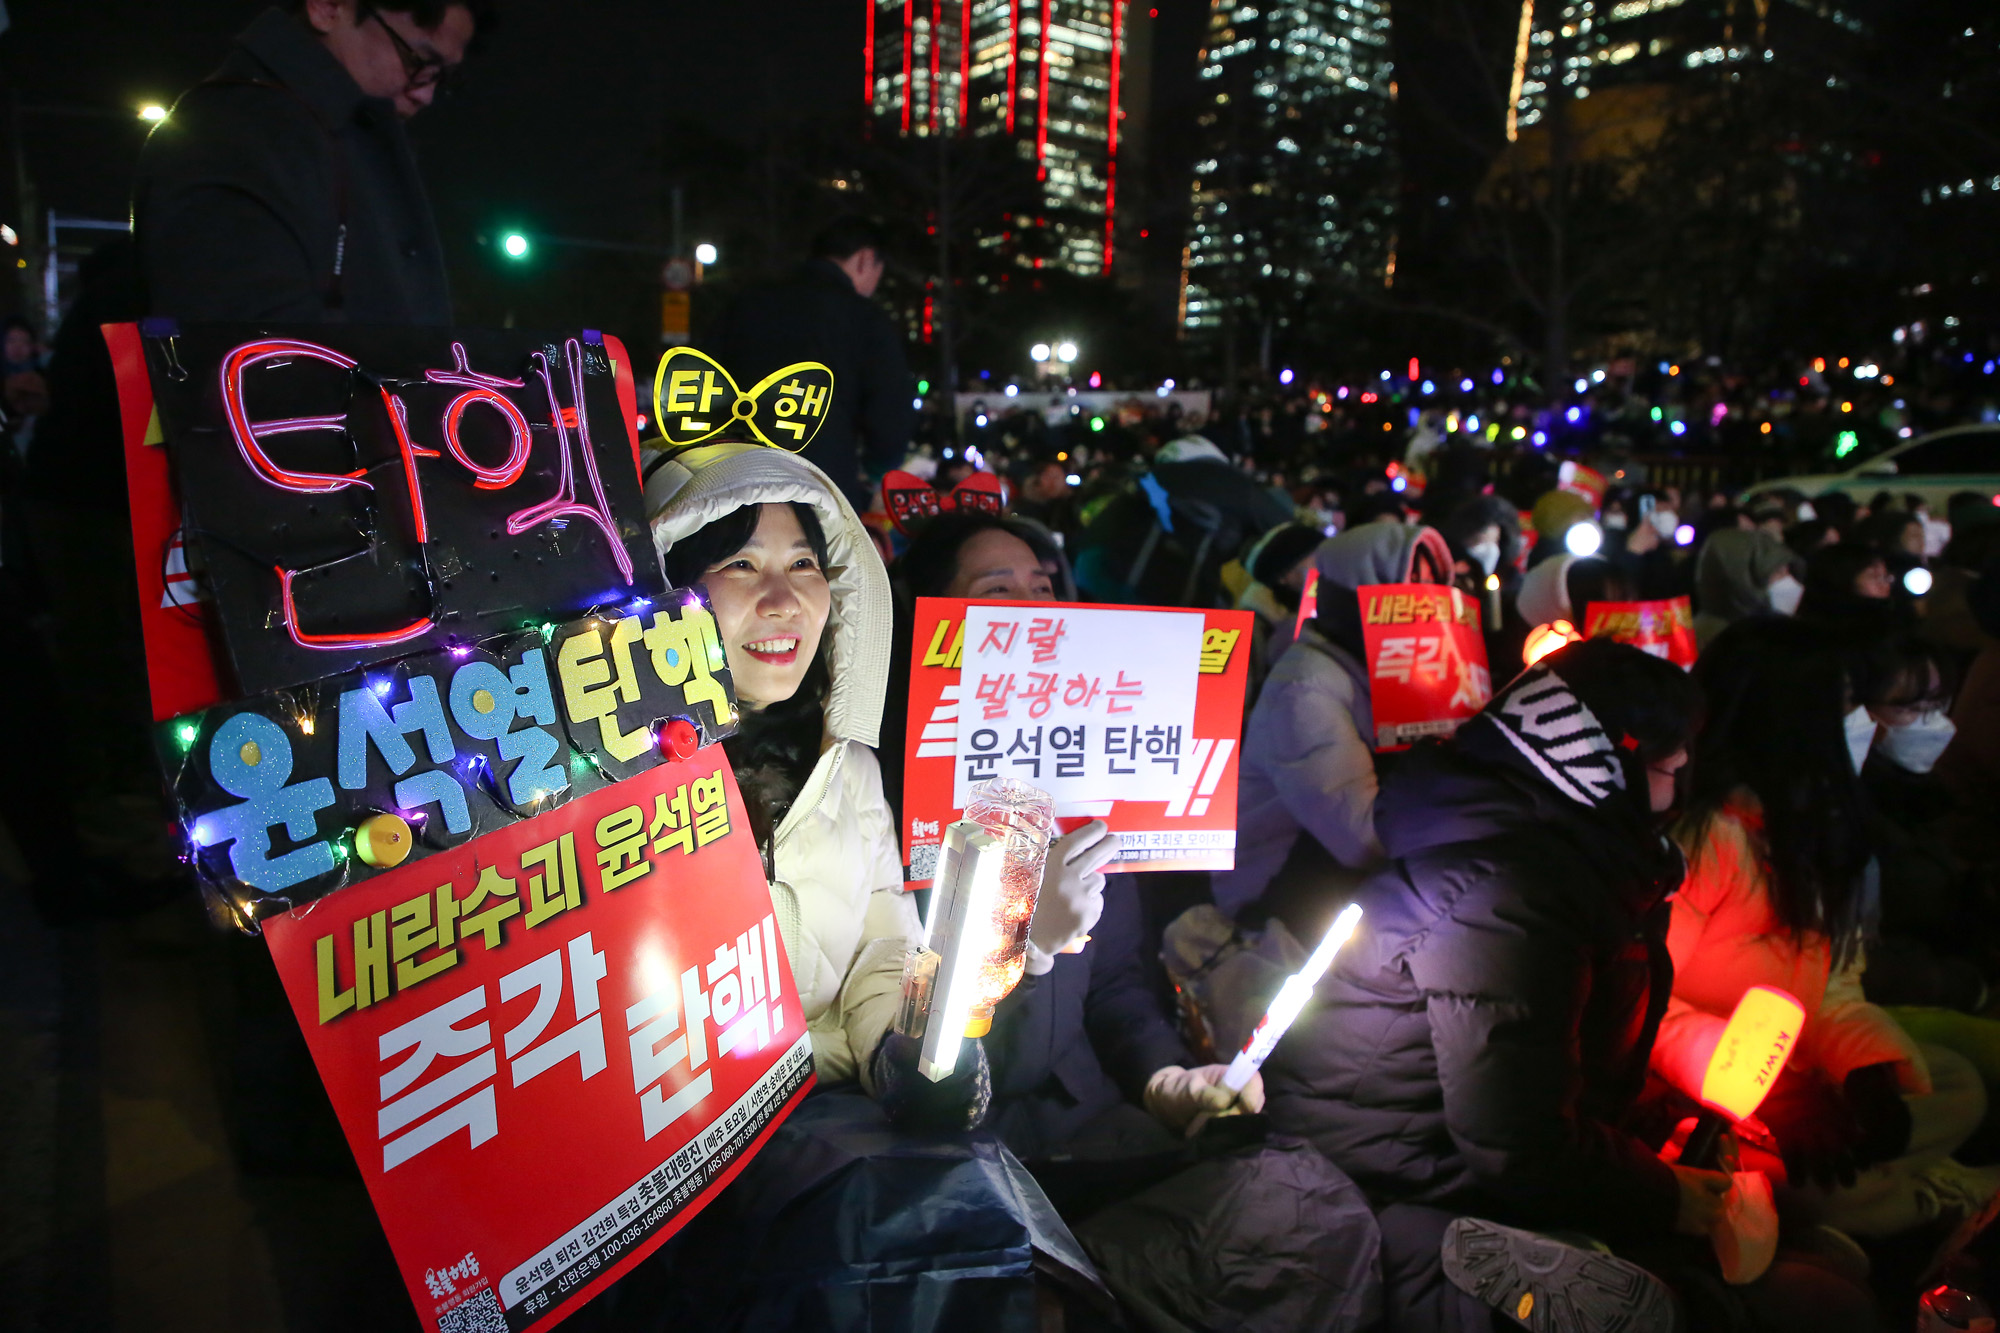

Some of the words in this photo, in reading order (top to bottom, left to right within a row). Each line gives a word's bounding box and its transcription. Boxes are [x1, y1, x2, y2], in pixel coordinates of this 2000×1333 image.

[220, 337, 635, 650] 탄핵
[975, 670, 1143, 720] 발광하는
[977, 617, 1066, 664] 지랄
[194, 659, 569, 893] 윤석열
[556, 604, 733, 766] 탄핵
[963, 724, 1087, 782] 윤석열
[1104, 724, 1182, 776] 탄핵
[316, 834, 581, 1026] 내란수괴
[593, 768, 732, 895] 윤석열
[378, 930, 608, 1173] 즉각
[625, 912, 785, 1142] 탄핵!
[425, 1251, 480, 1299] 촛불행동
[515, 1257, 556, 1295] 윤석열
[555, 1238, 582, 1265] 퇴진
[582, 1213, 618, 1248] 김건희
[617, 1196, 641, 1221] 특검
[637, 1140, 704, 1206] 촛불대행진
[703, 1126, 725, 1155] (매주
[724, 1104, 748, 1135] 토요일
[523, 1290, 550, 1315] 후원
[557, 1253, 601, 1293] 신한은행
[601, 1198, 674, 1261] 100-036-164860
[672, 1172, 703, 1206] 촛불행동
[707, 1156, 722, 1176] ARS
[721, 1120, 758, 1162] 060-707-3300
